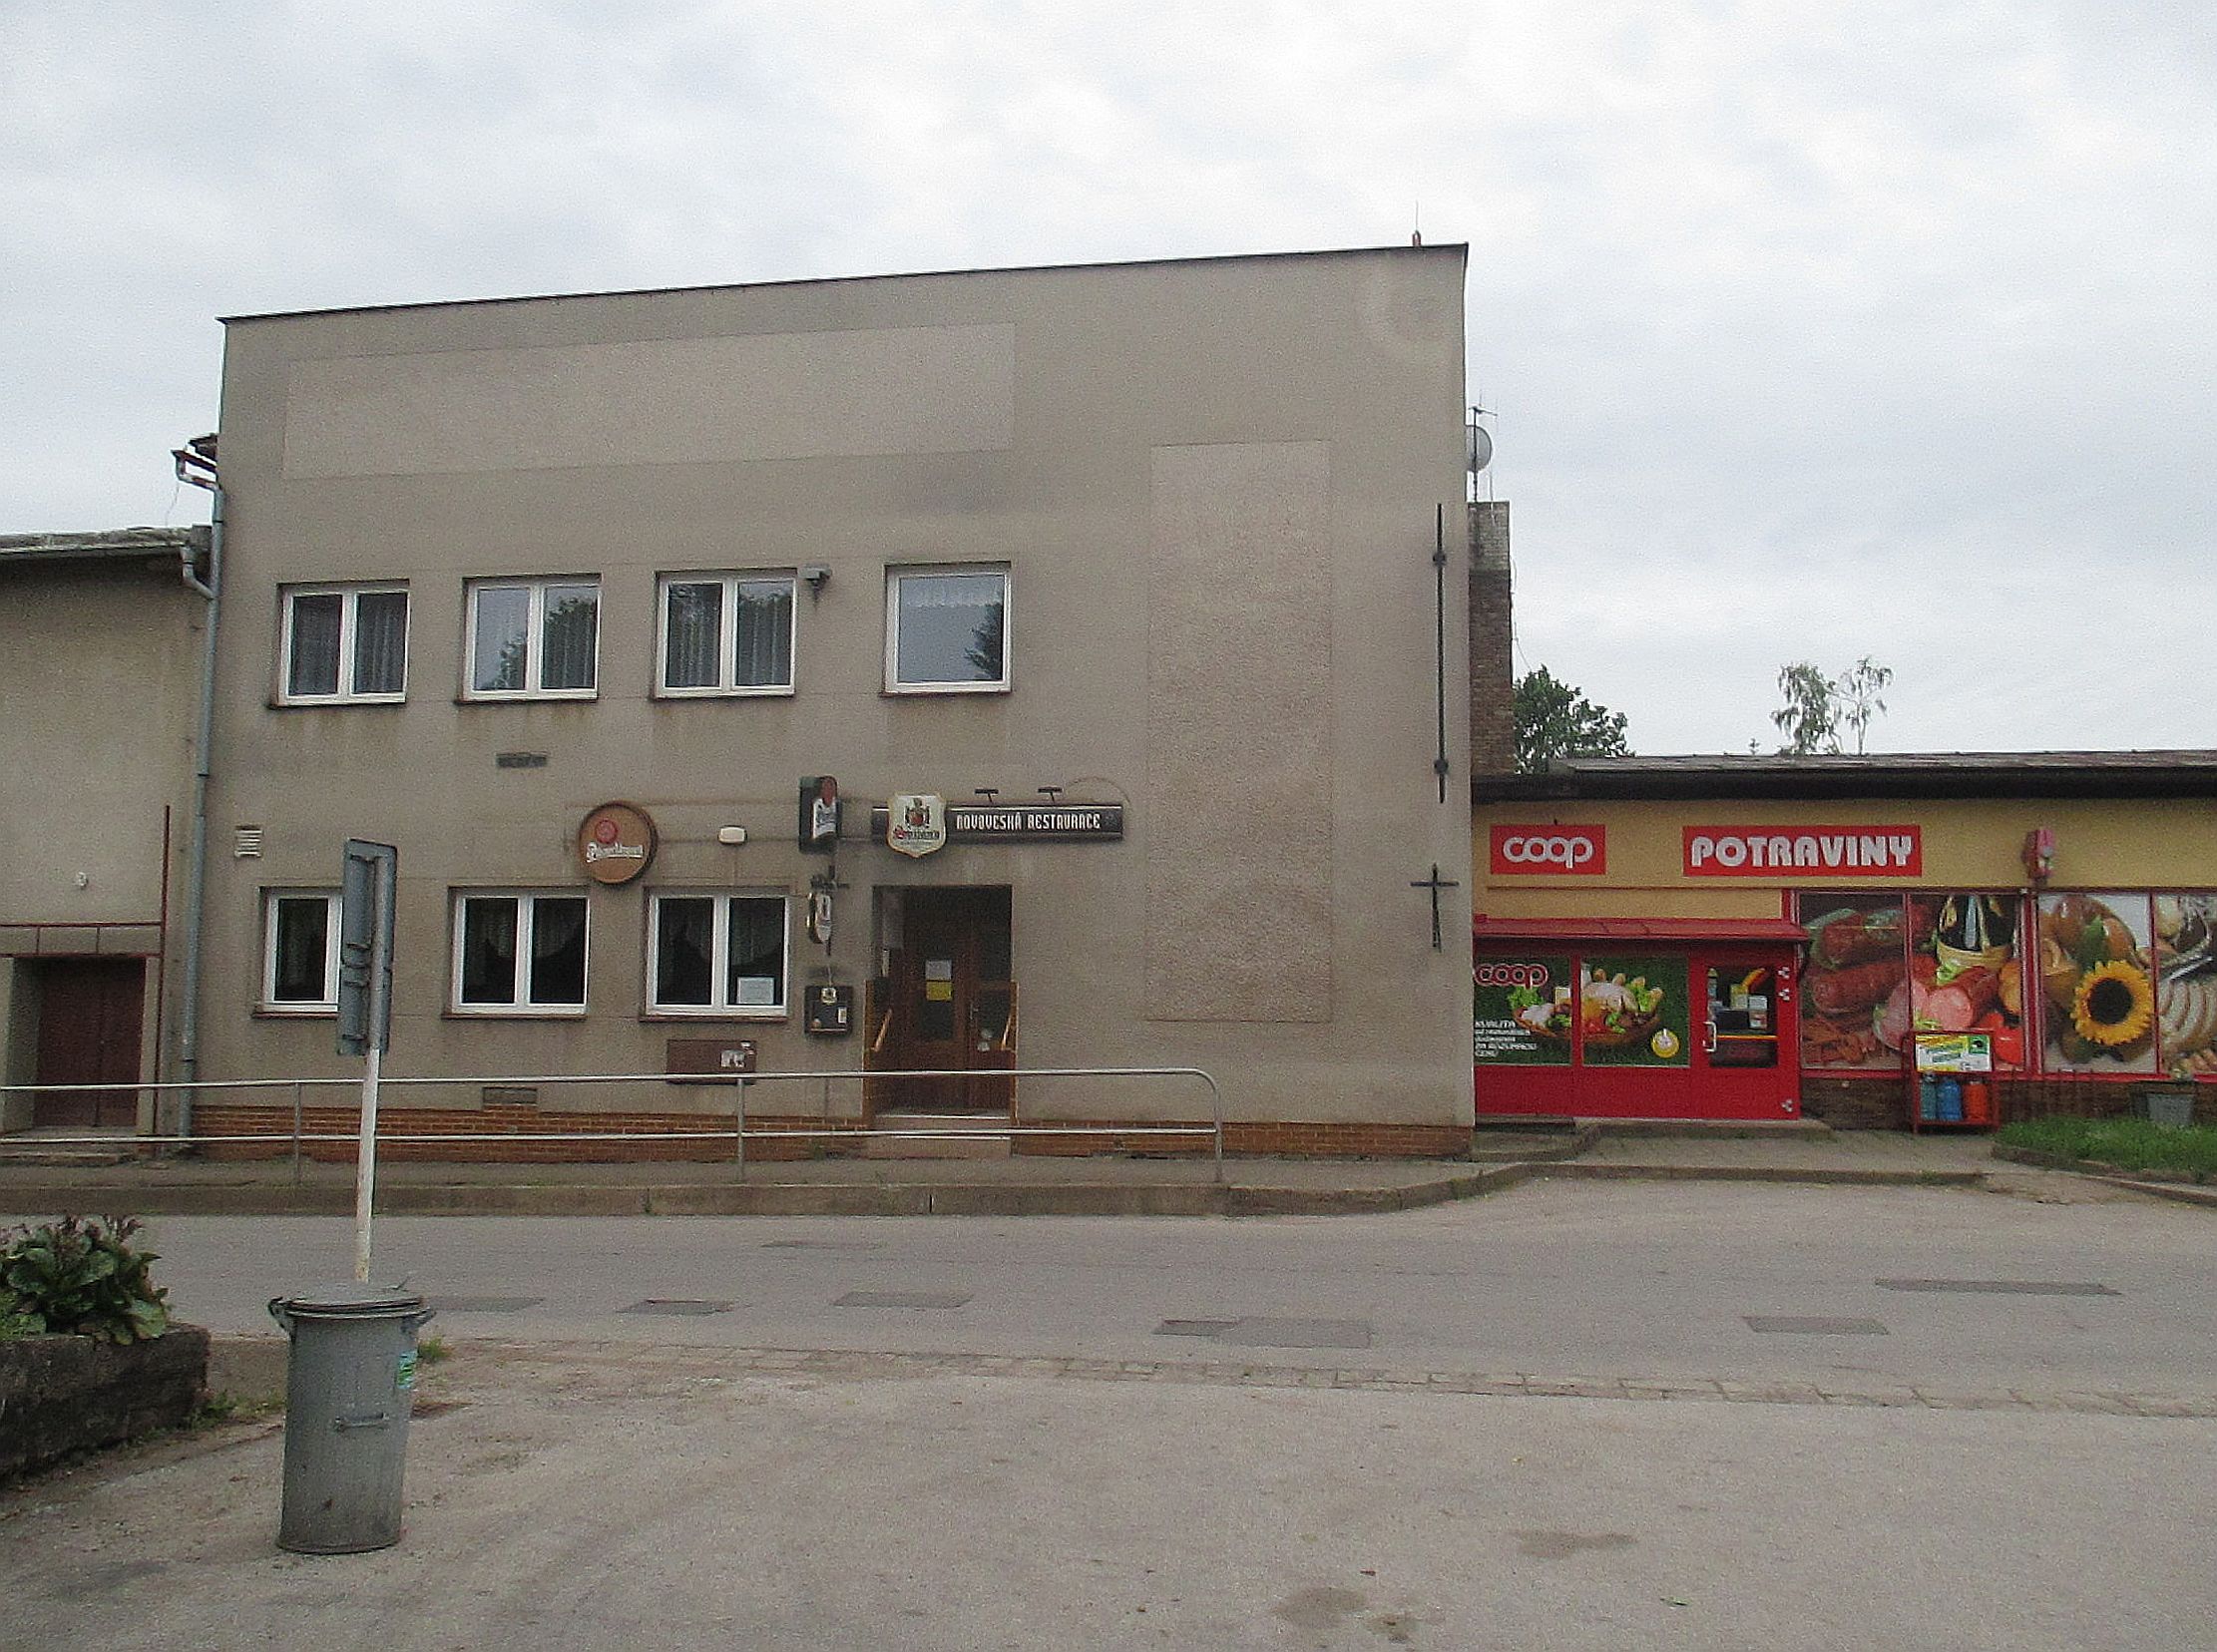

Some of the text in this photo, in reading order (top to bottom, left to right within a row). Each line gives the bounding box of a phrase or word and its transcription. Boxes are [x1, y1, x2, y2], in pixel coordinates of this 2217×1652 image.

[956, 811, 1102, 830] NOVOVESKÁ RESTAURACE
[1503, 836, 1594, 869] coop
[1691, 835, 1913, 868] POTRAVINY
